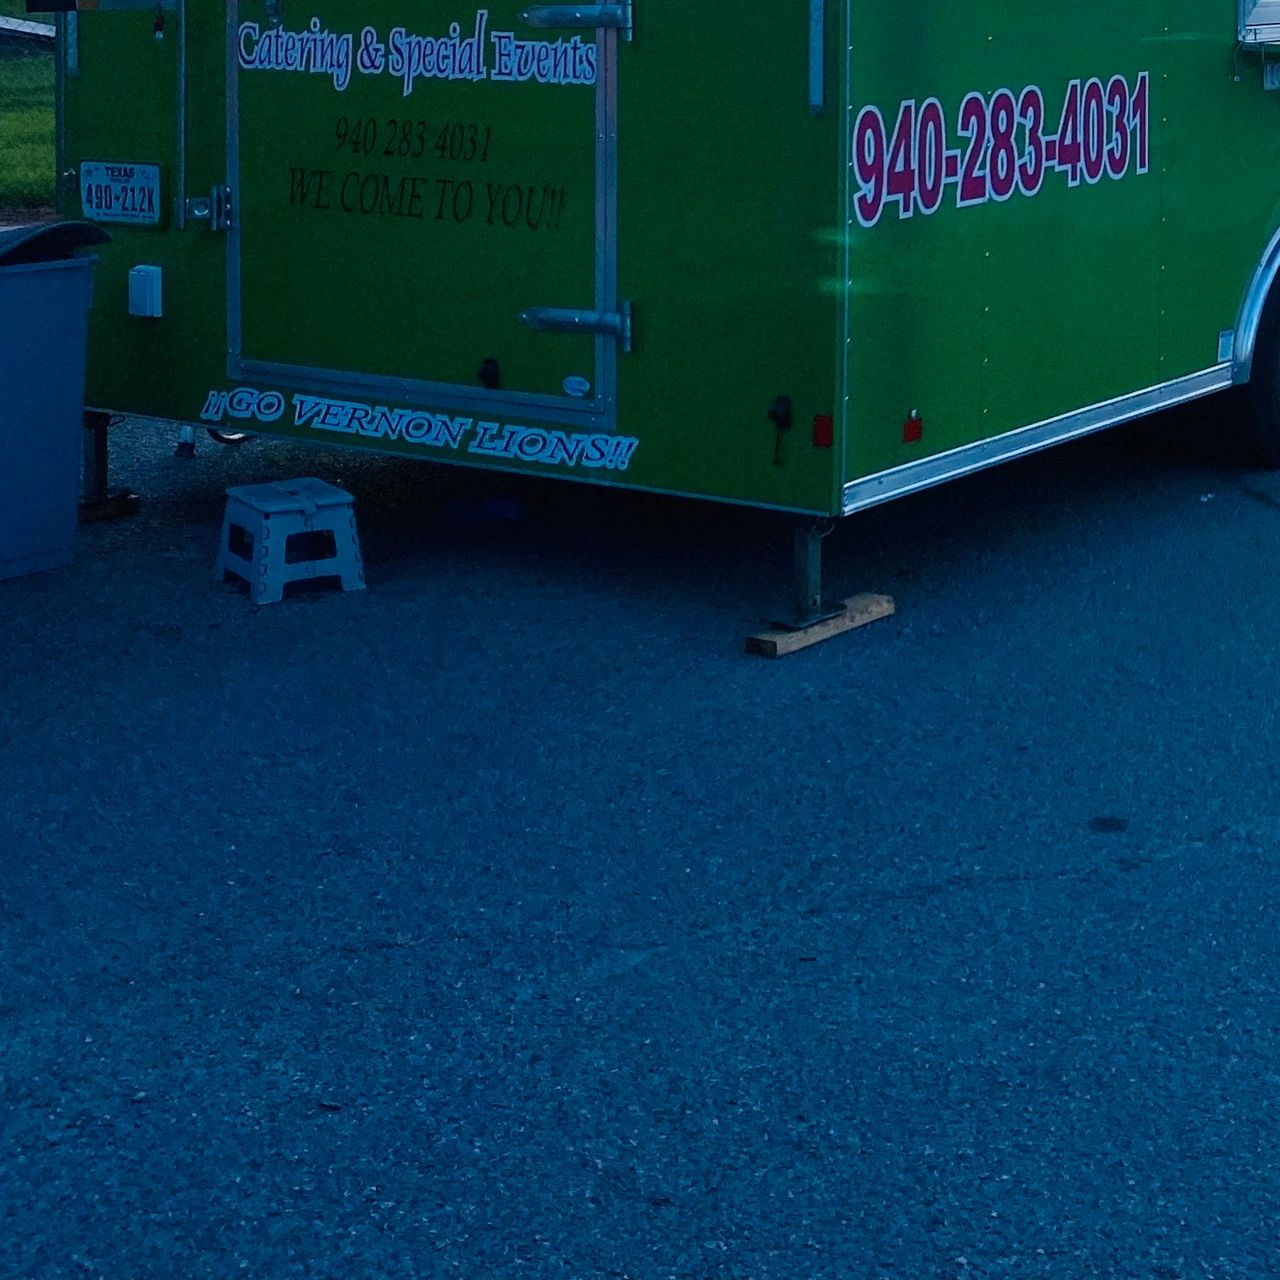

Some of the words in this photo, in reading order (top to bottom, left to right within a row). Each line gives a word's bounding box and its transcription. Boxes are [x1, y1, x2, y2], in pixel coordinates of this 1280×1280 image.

[238, 17, 352, 91] Catering
[357, 26, 384, 74] &
[388, 10, 486, 96] Special
[490, 31, 597, 85] Events
[335, 117, 377, 155] 940
[383, 119, 426, 158] 283
[433, 123, 493, 164] 4031
[853, 71, 1149, 227] 940-283-4031
[289, 167, 333, 210] WE
[341, 171, 426, 220] COME
[434, 179, 474, 222] TO
[293, 394, 472, 448] VERNON
[467, 421, 639, 470] LIONS!!
